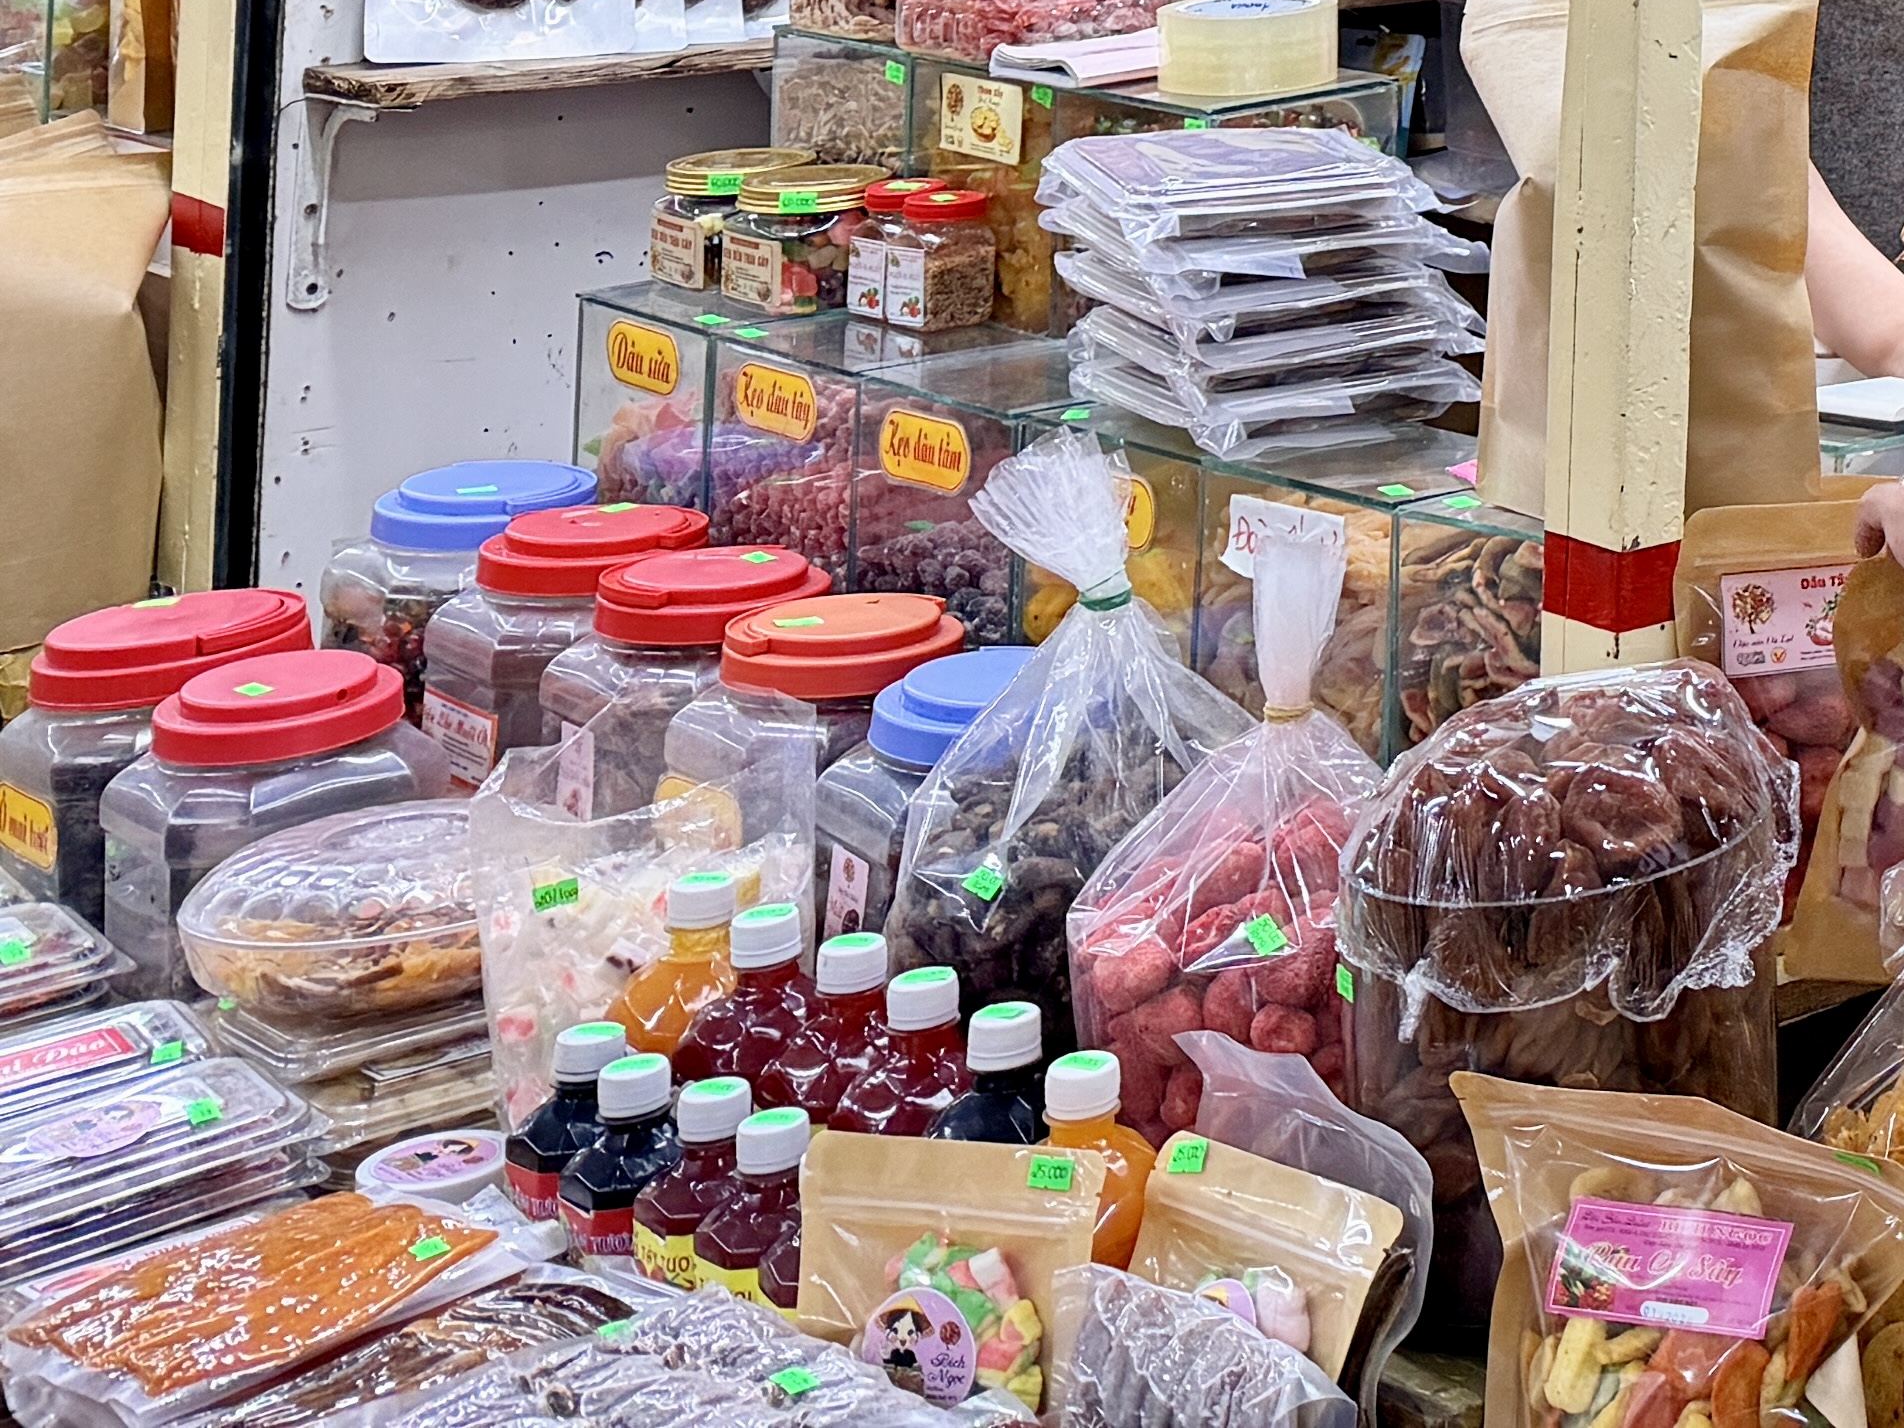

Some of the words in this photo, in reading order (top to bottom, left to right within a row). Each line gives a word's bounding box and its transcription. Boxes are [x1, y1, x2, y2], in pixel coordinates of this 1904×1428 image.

[613, 331, 643, 375] Dâu
[738, 371, 764, 418] Kẹo
[884, 418, 911, 467] Kẹo
